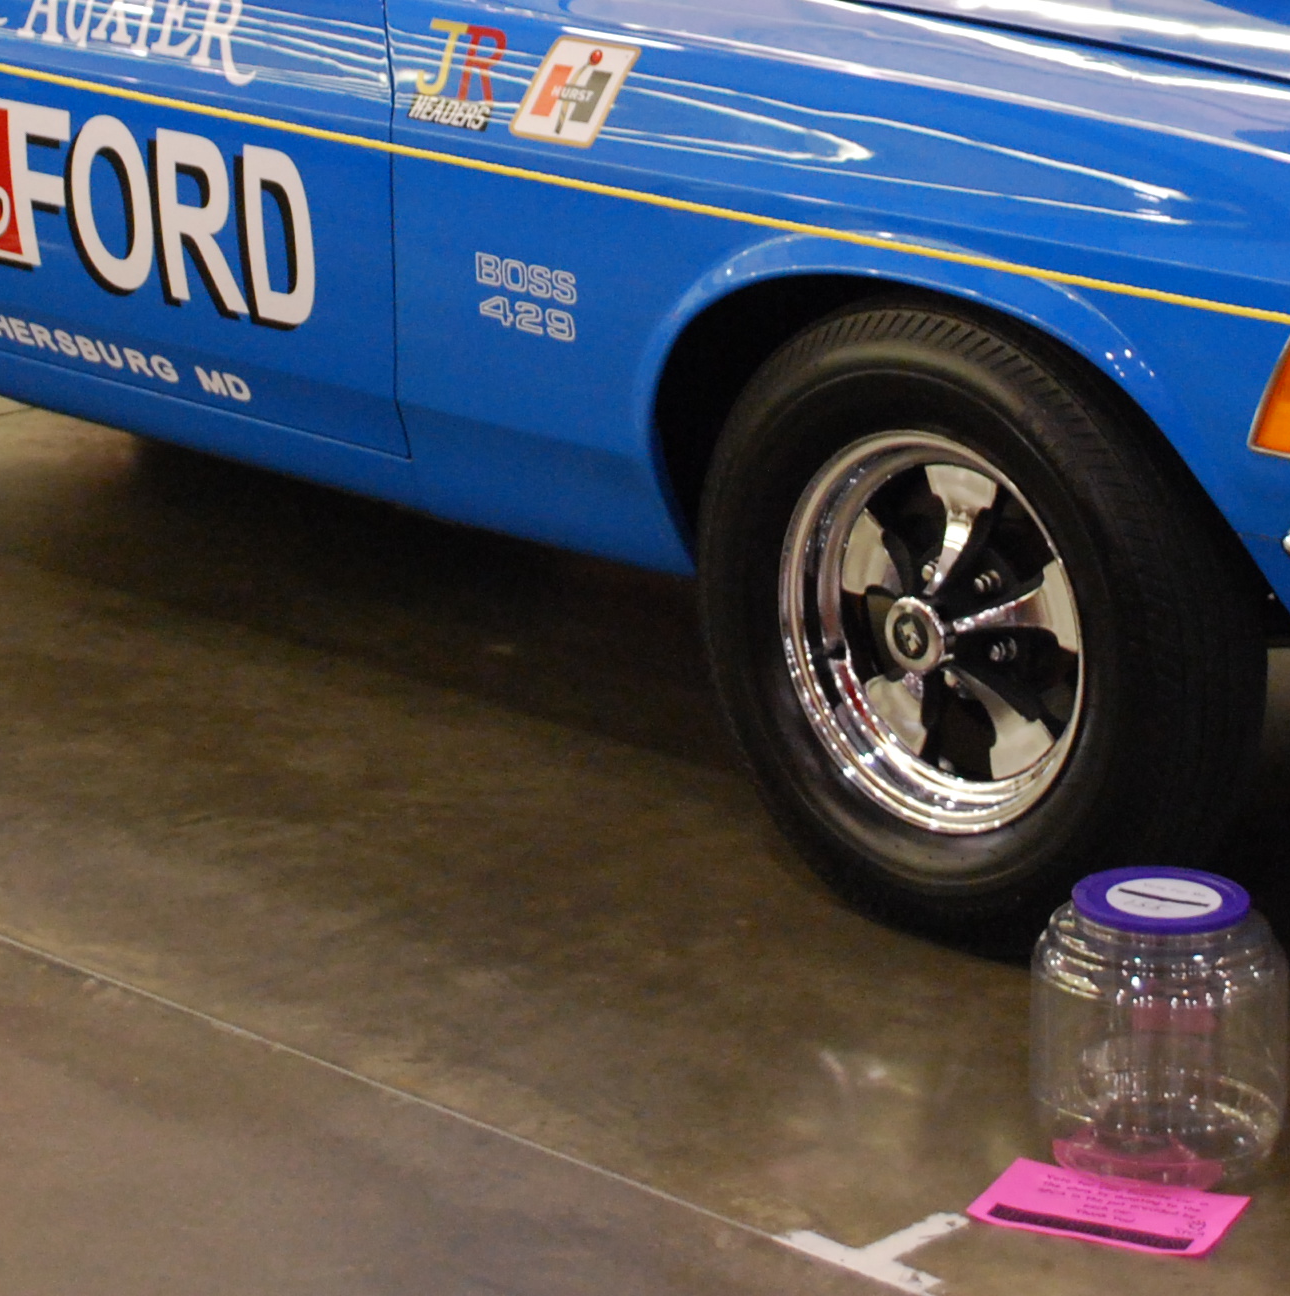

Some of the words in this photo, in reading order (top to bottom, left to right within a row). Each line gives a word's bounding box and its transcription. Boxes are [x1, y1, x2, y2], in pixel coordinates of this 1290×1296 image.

[415, 17, 506, 107] JR
[408, 94, 494, 131] HEADERS
[550, 84, 594, 104] HURST
[8, 104, 316, 328] FORD
[475, 251, 577, 305] BOSS
[479, 295, 577, 342] 429
[194, 364, 252, 403] MD
